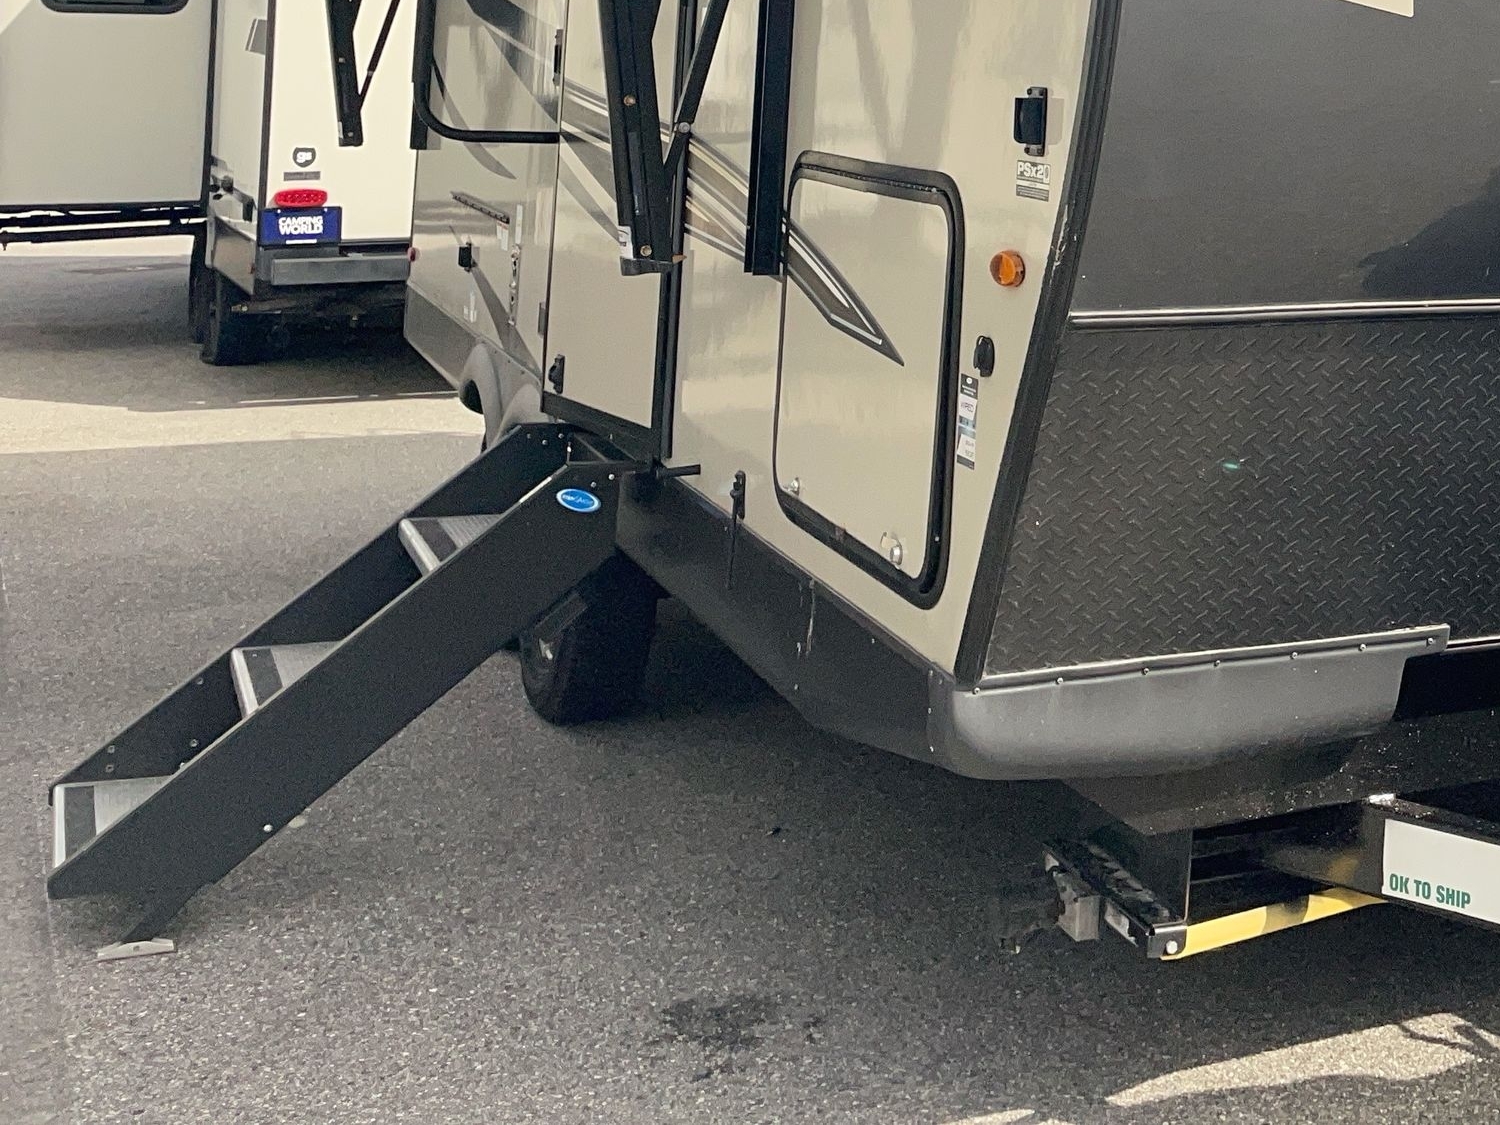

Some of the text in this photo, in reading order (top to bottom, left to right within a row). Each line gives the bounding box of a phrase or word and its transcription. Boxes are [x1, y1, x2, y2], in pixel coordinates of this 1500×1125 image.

[278, 215, 323, 226] CAMPING
[279, 224, 323, 235] WORLD
[1389, 873, 1471, 909] OK TO SHIP
